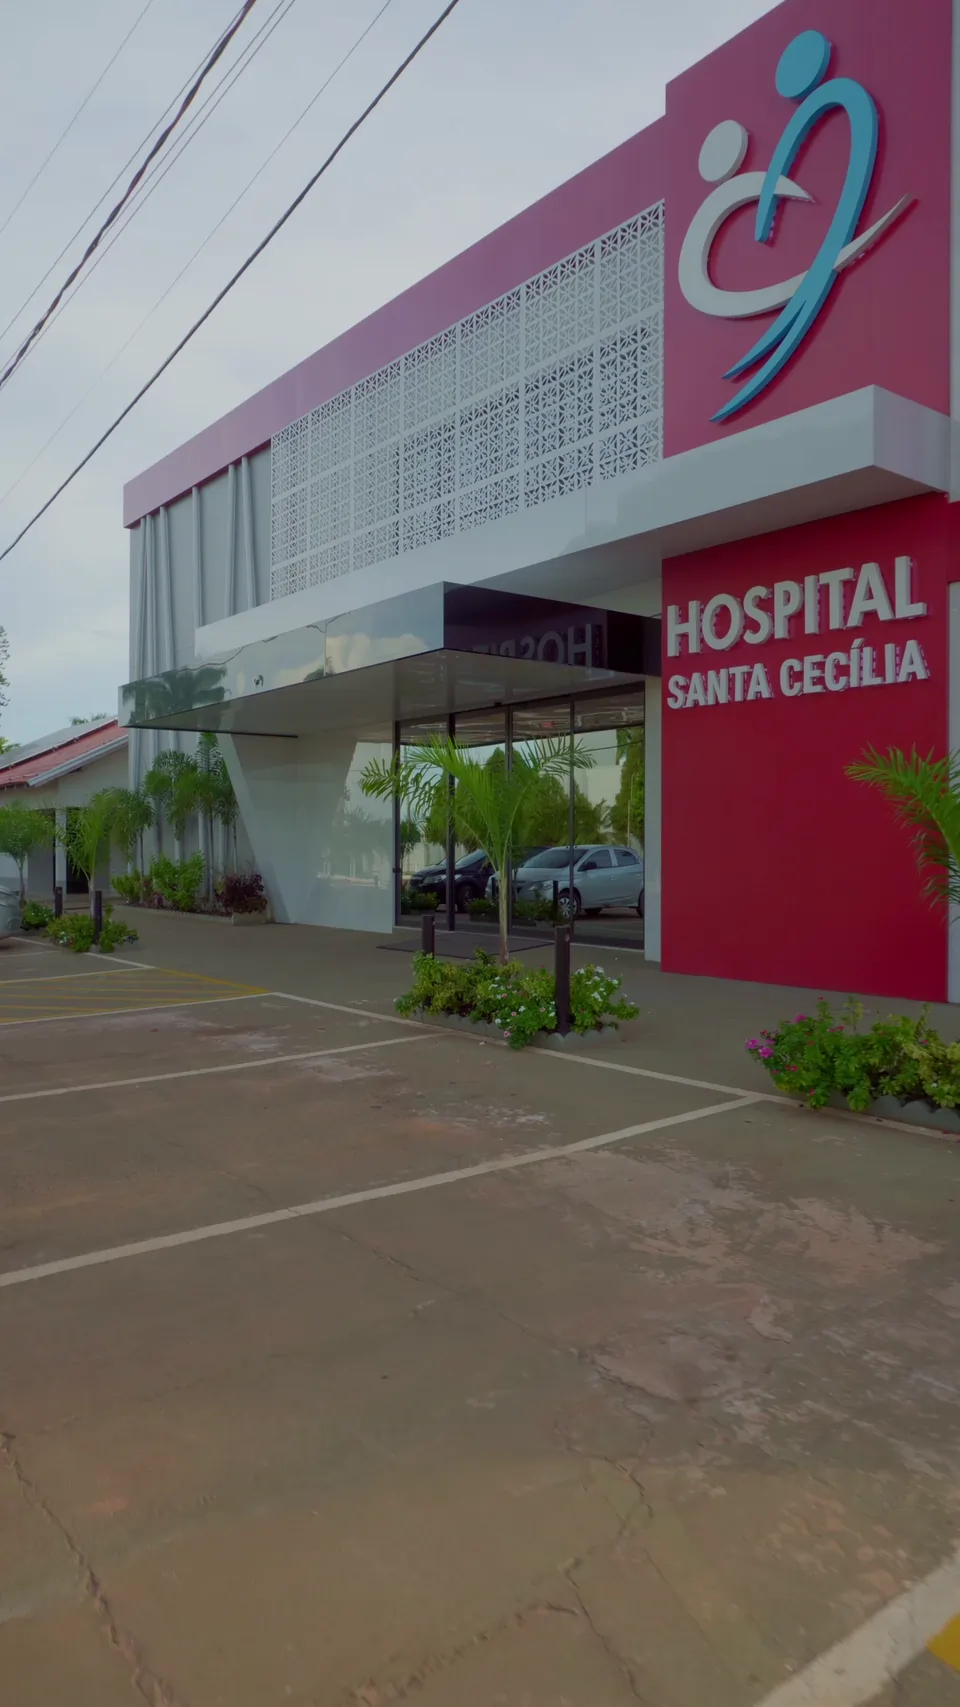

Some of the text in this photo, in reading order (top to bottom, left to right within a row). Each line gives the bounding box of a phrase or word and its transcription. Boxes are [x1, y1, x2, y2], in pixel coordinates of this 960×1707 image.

[667, 555, 927, 657] HOSPITAL
[666, 637, 930, 709] SANTA CECÍLIA
